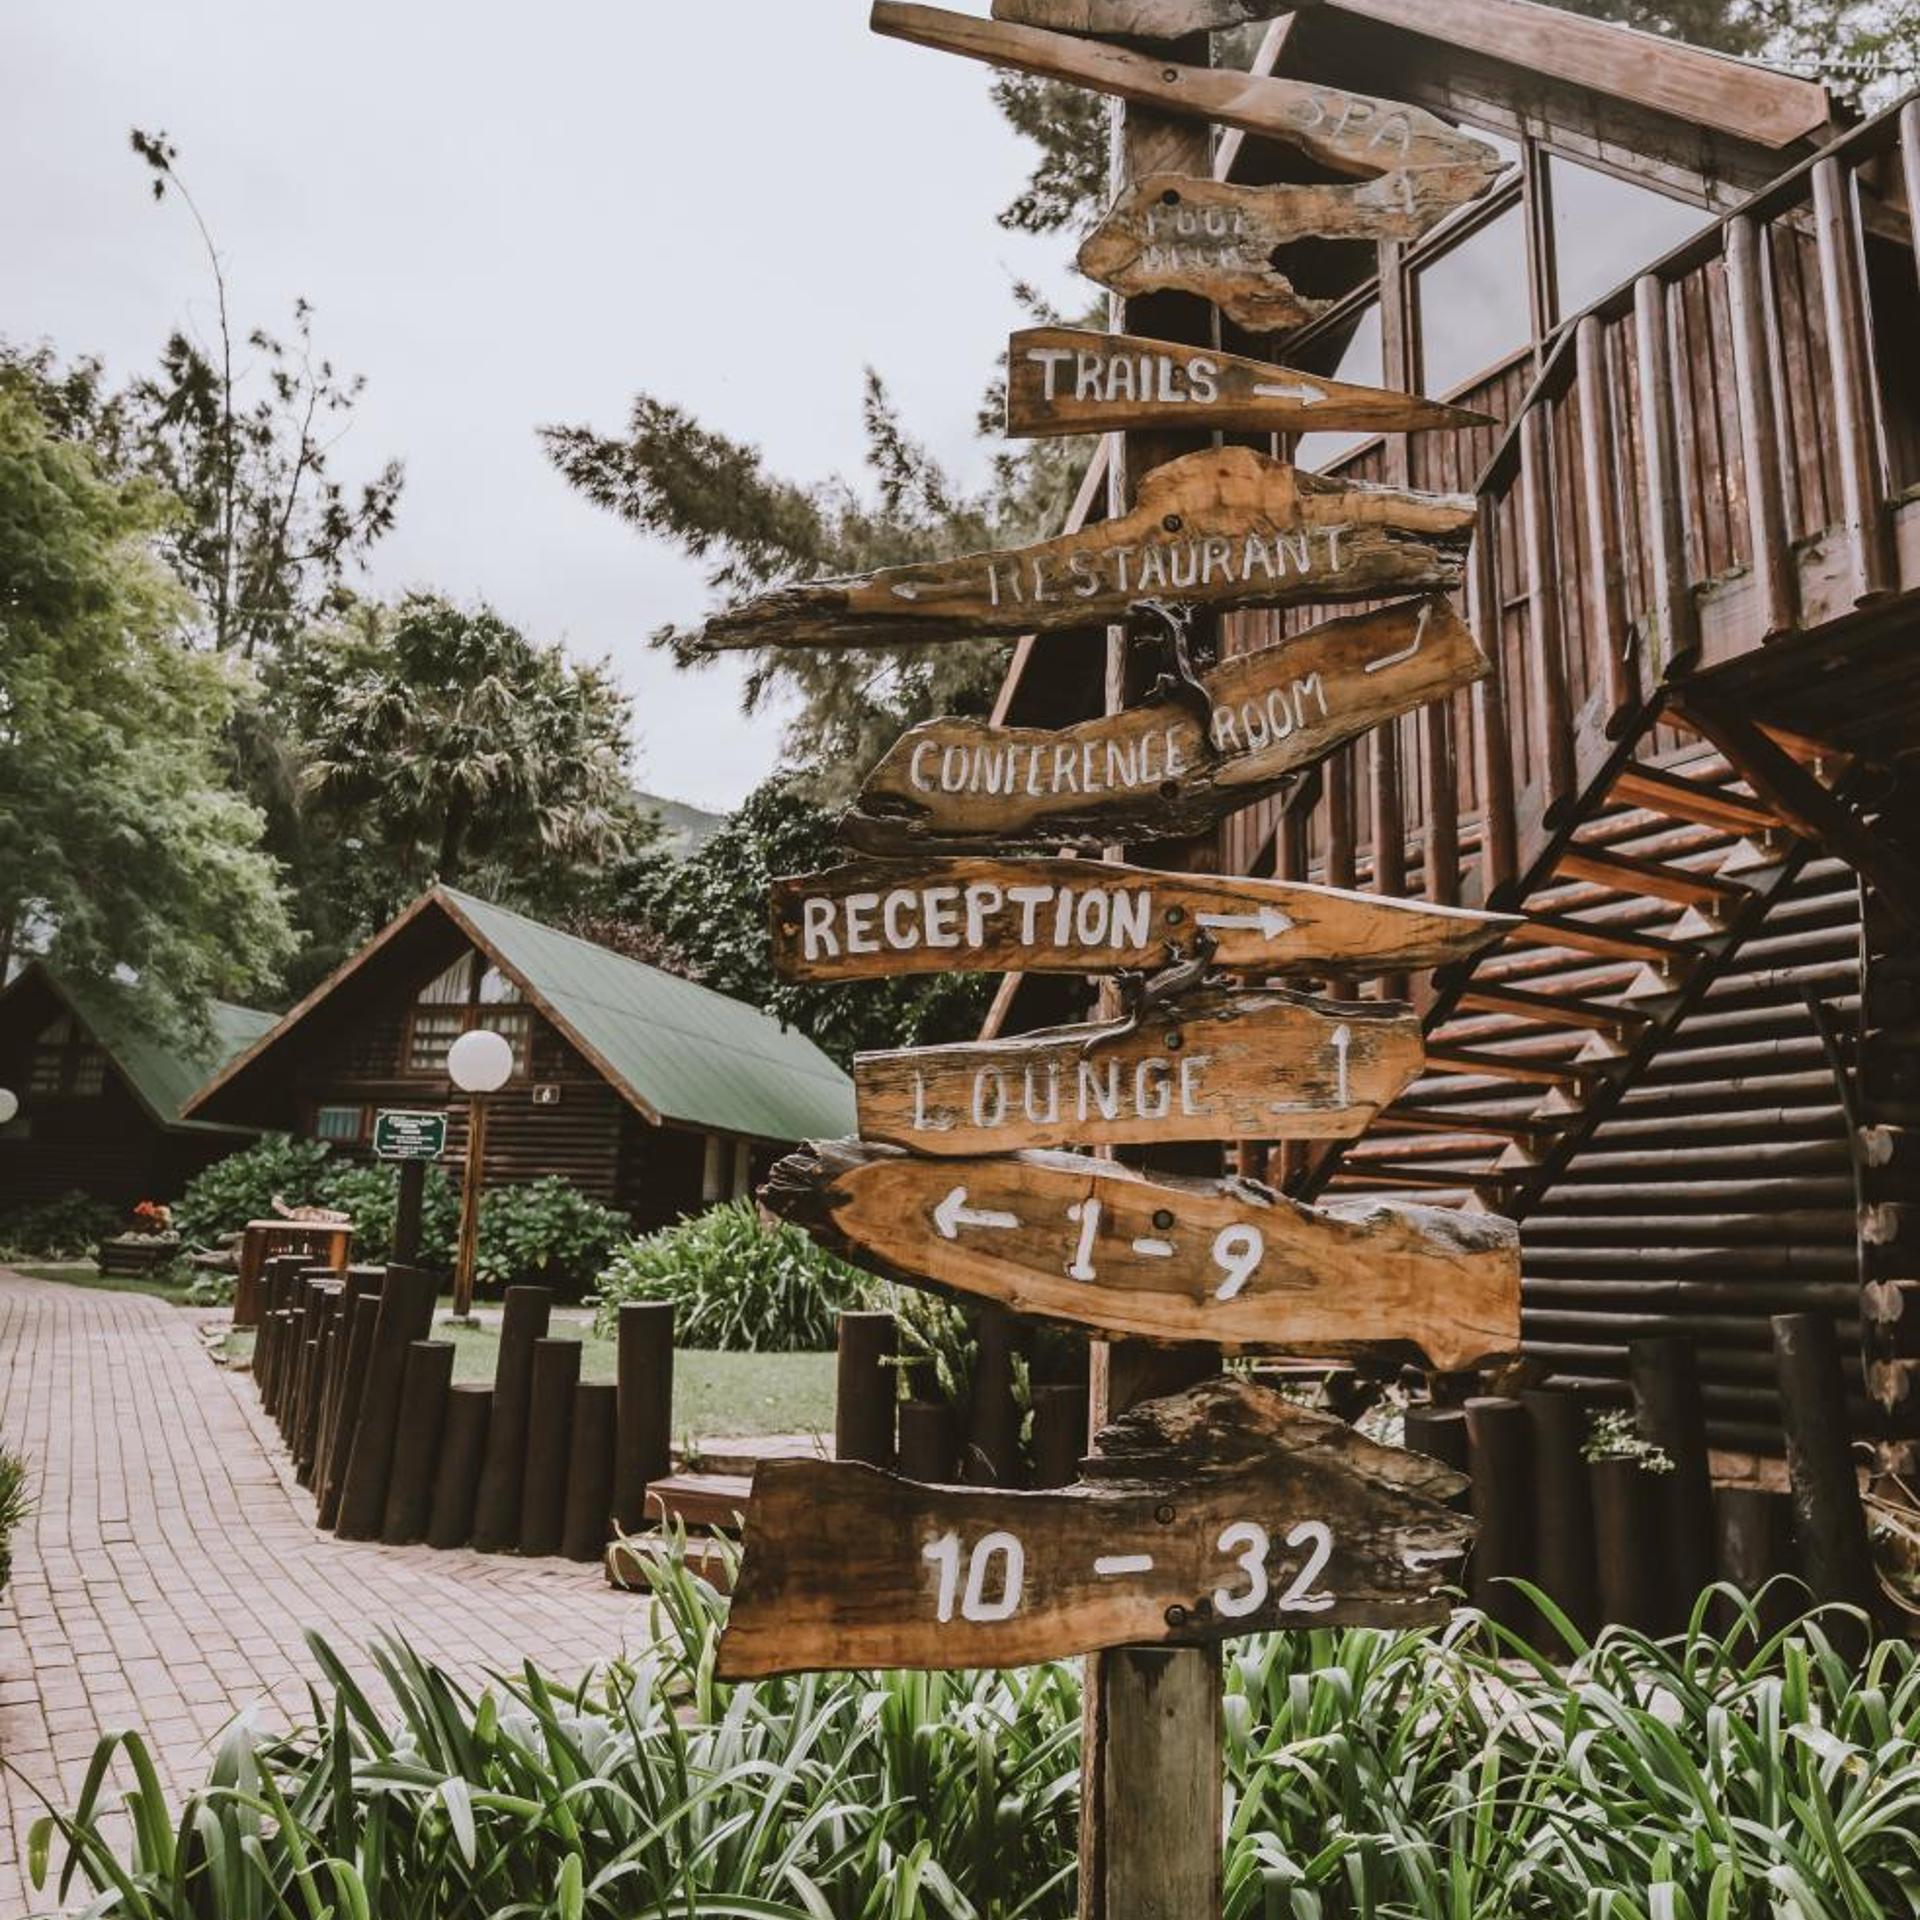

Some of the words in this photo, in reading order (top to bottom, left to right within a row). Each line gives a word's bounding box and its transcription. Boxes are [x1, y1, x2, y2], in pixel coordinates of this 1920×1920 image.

[1027, 348, 1219, 405] TRAILS
[988, 524, 1352, 606] RESTAURANT
[910, 723, 1190, 797] CONFERENCE
[1210, 671, 1329, 752] ROOM
[803, 884, 1152, 962] RECEPTION
[913, 1053, 1212, 1132] LOUNGE
[922, 1531, 1025, 1623] 10
[1214, 1520, 1337, 1618] 32
